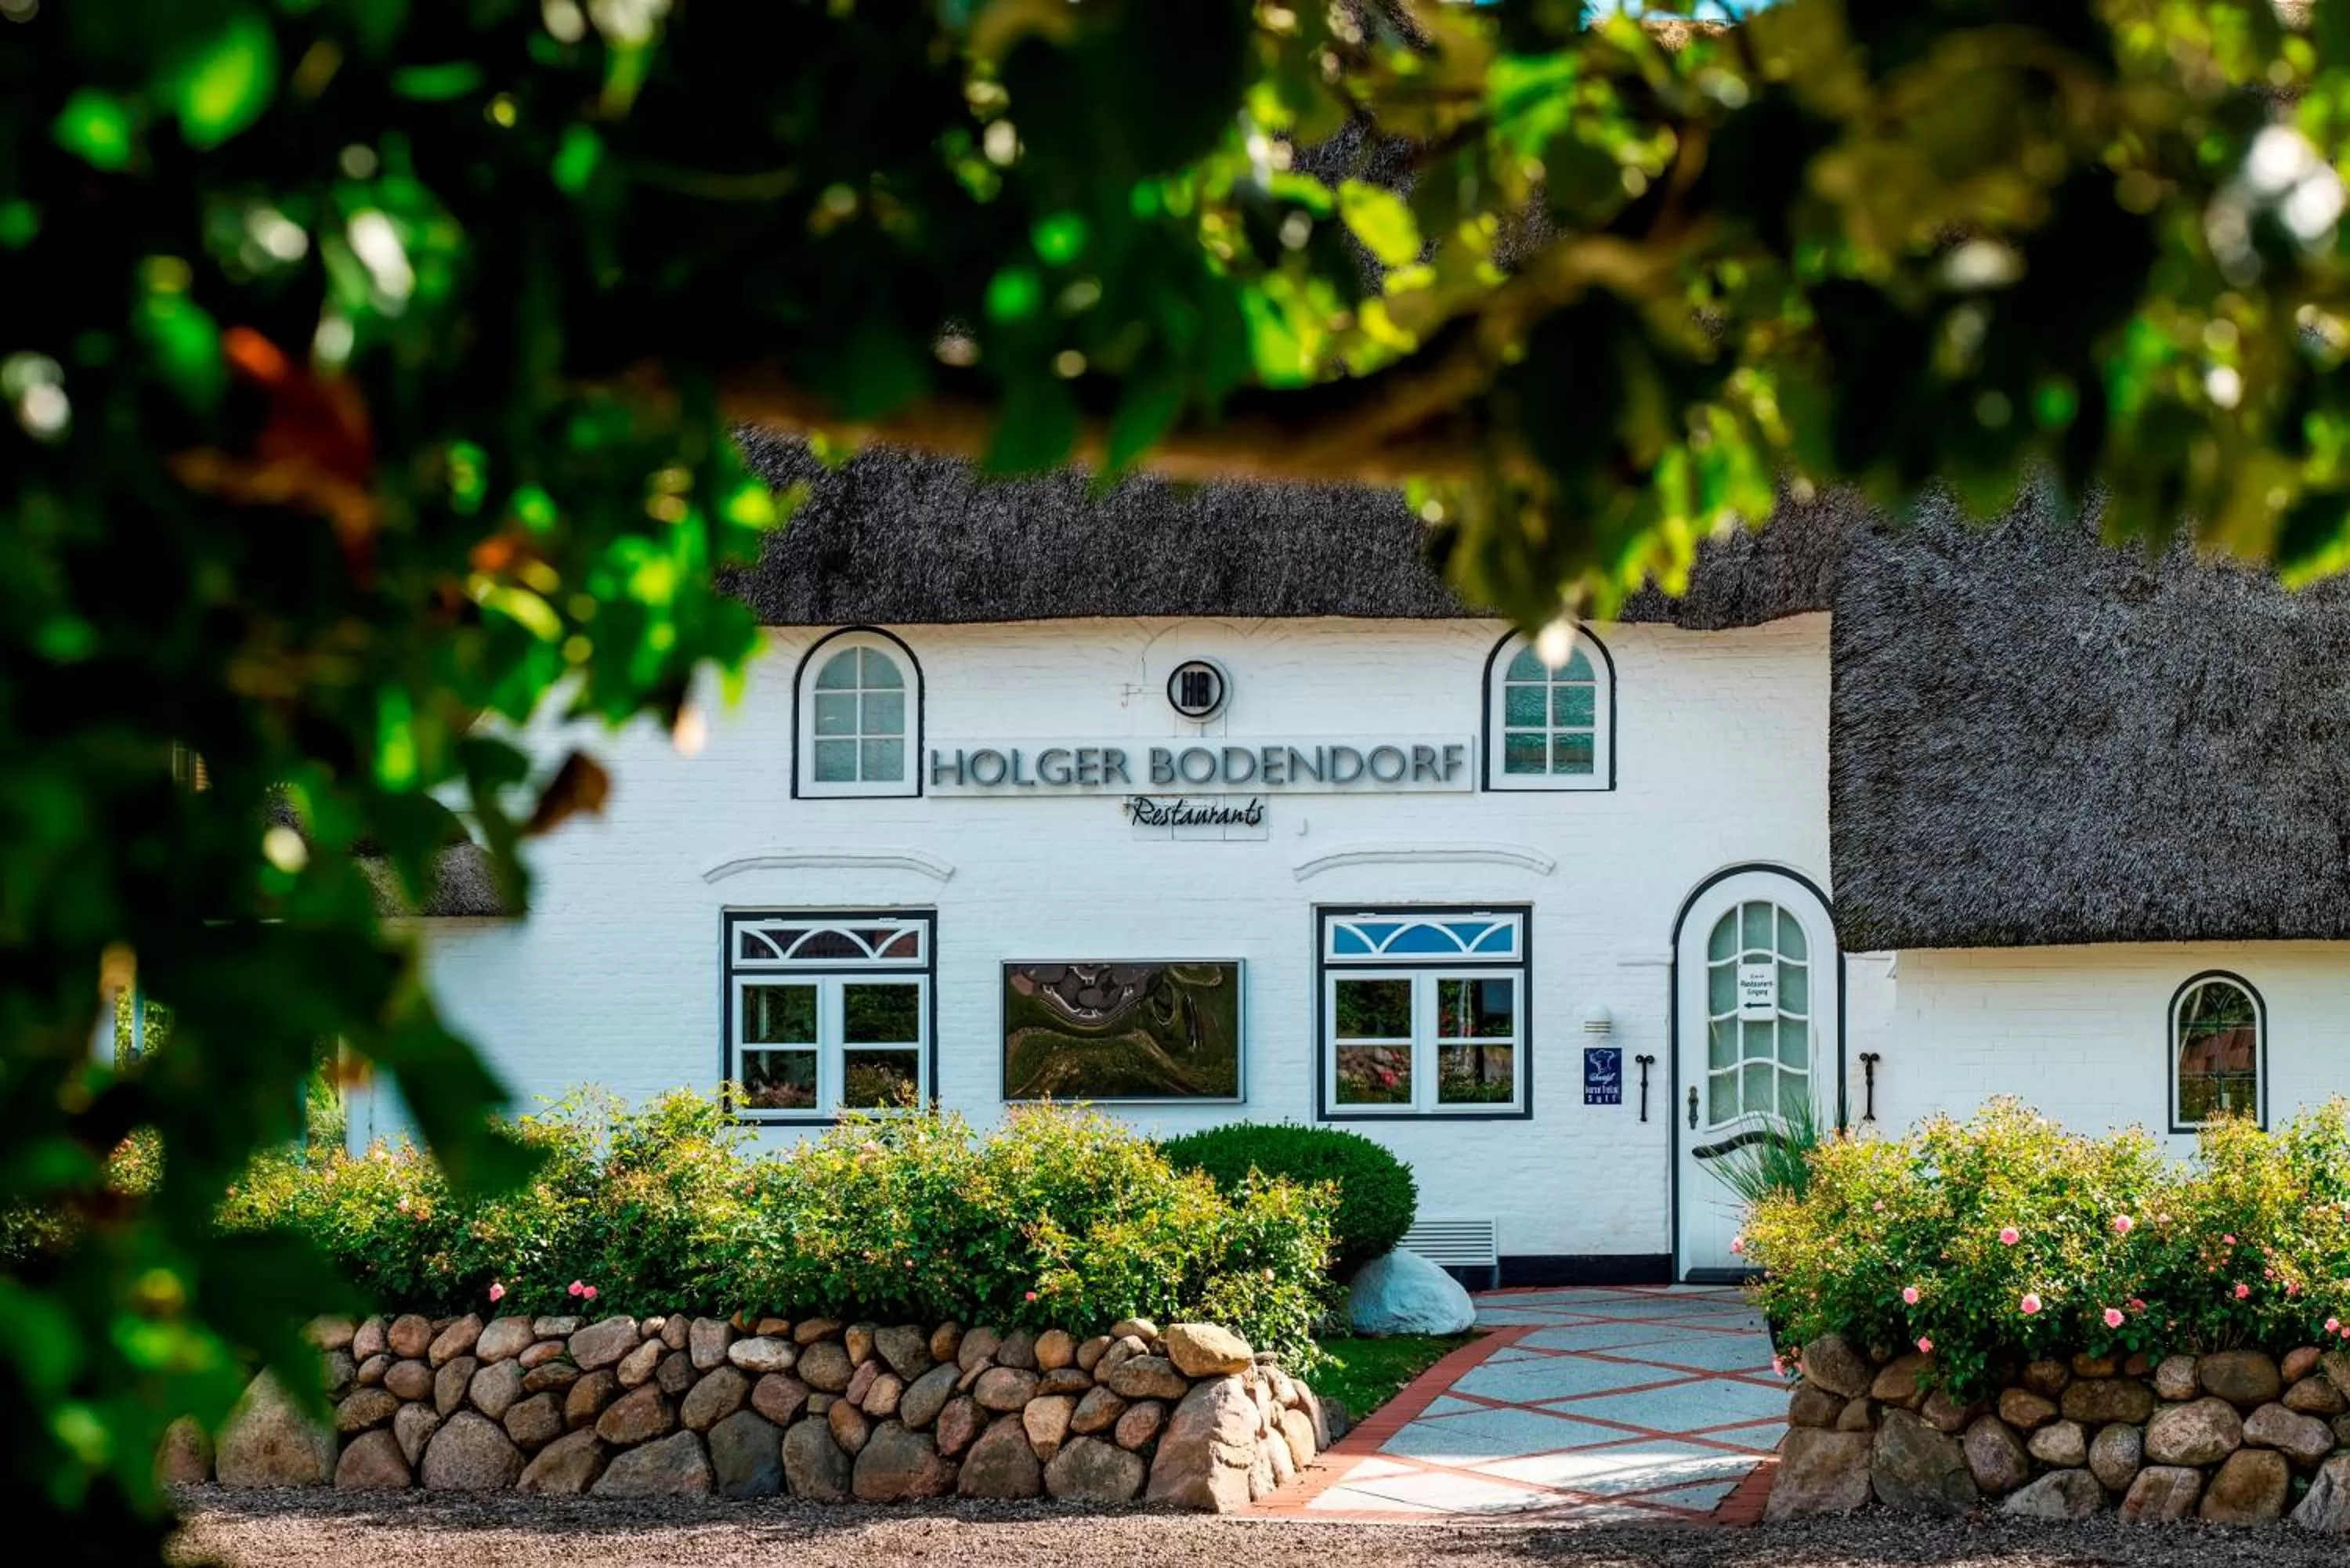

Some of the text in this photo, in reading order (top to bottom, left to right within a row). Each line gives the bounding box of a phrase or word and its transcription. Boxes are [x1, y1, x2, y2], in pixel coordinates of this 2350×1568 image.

[930, 744, 1464, 786] HOLGER BODENDORF
[1132, 797, 1264, 827] Restaurants
